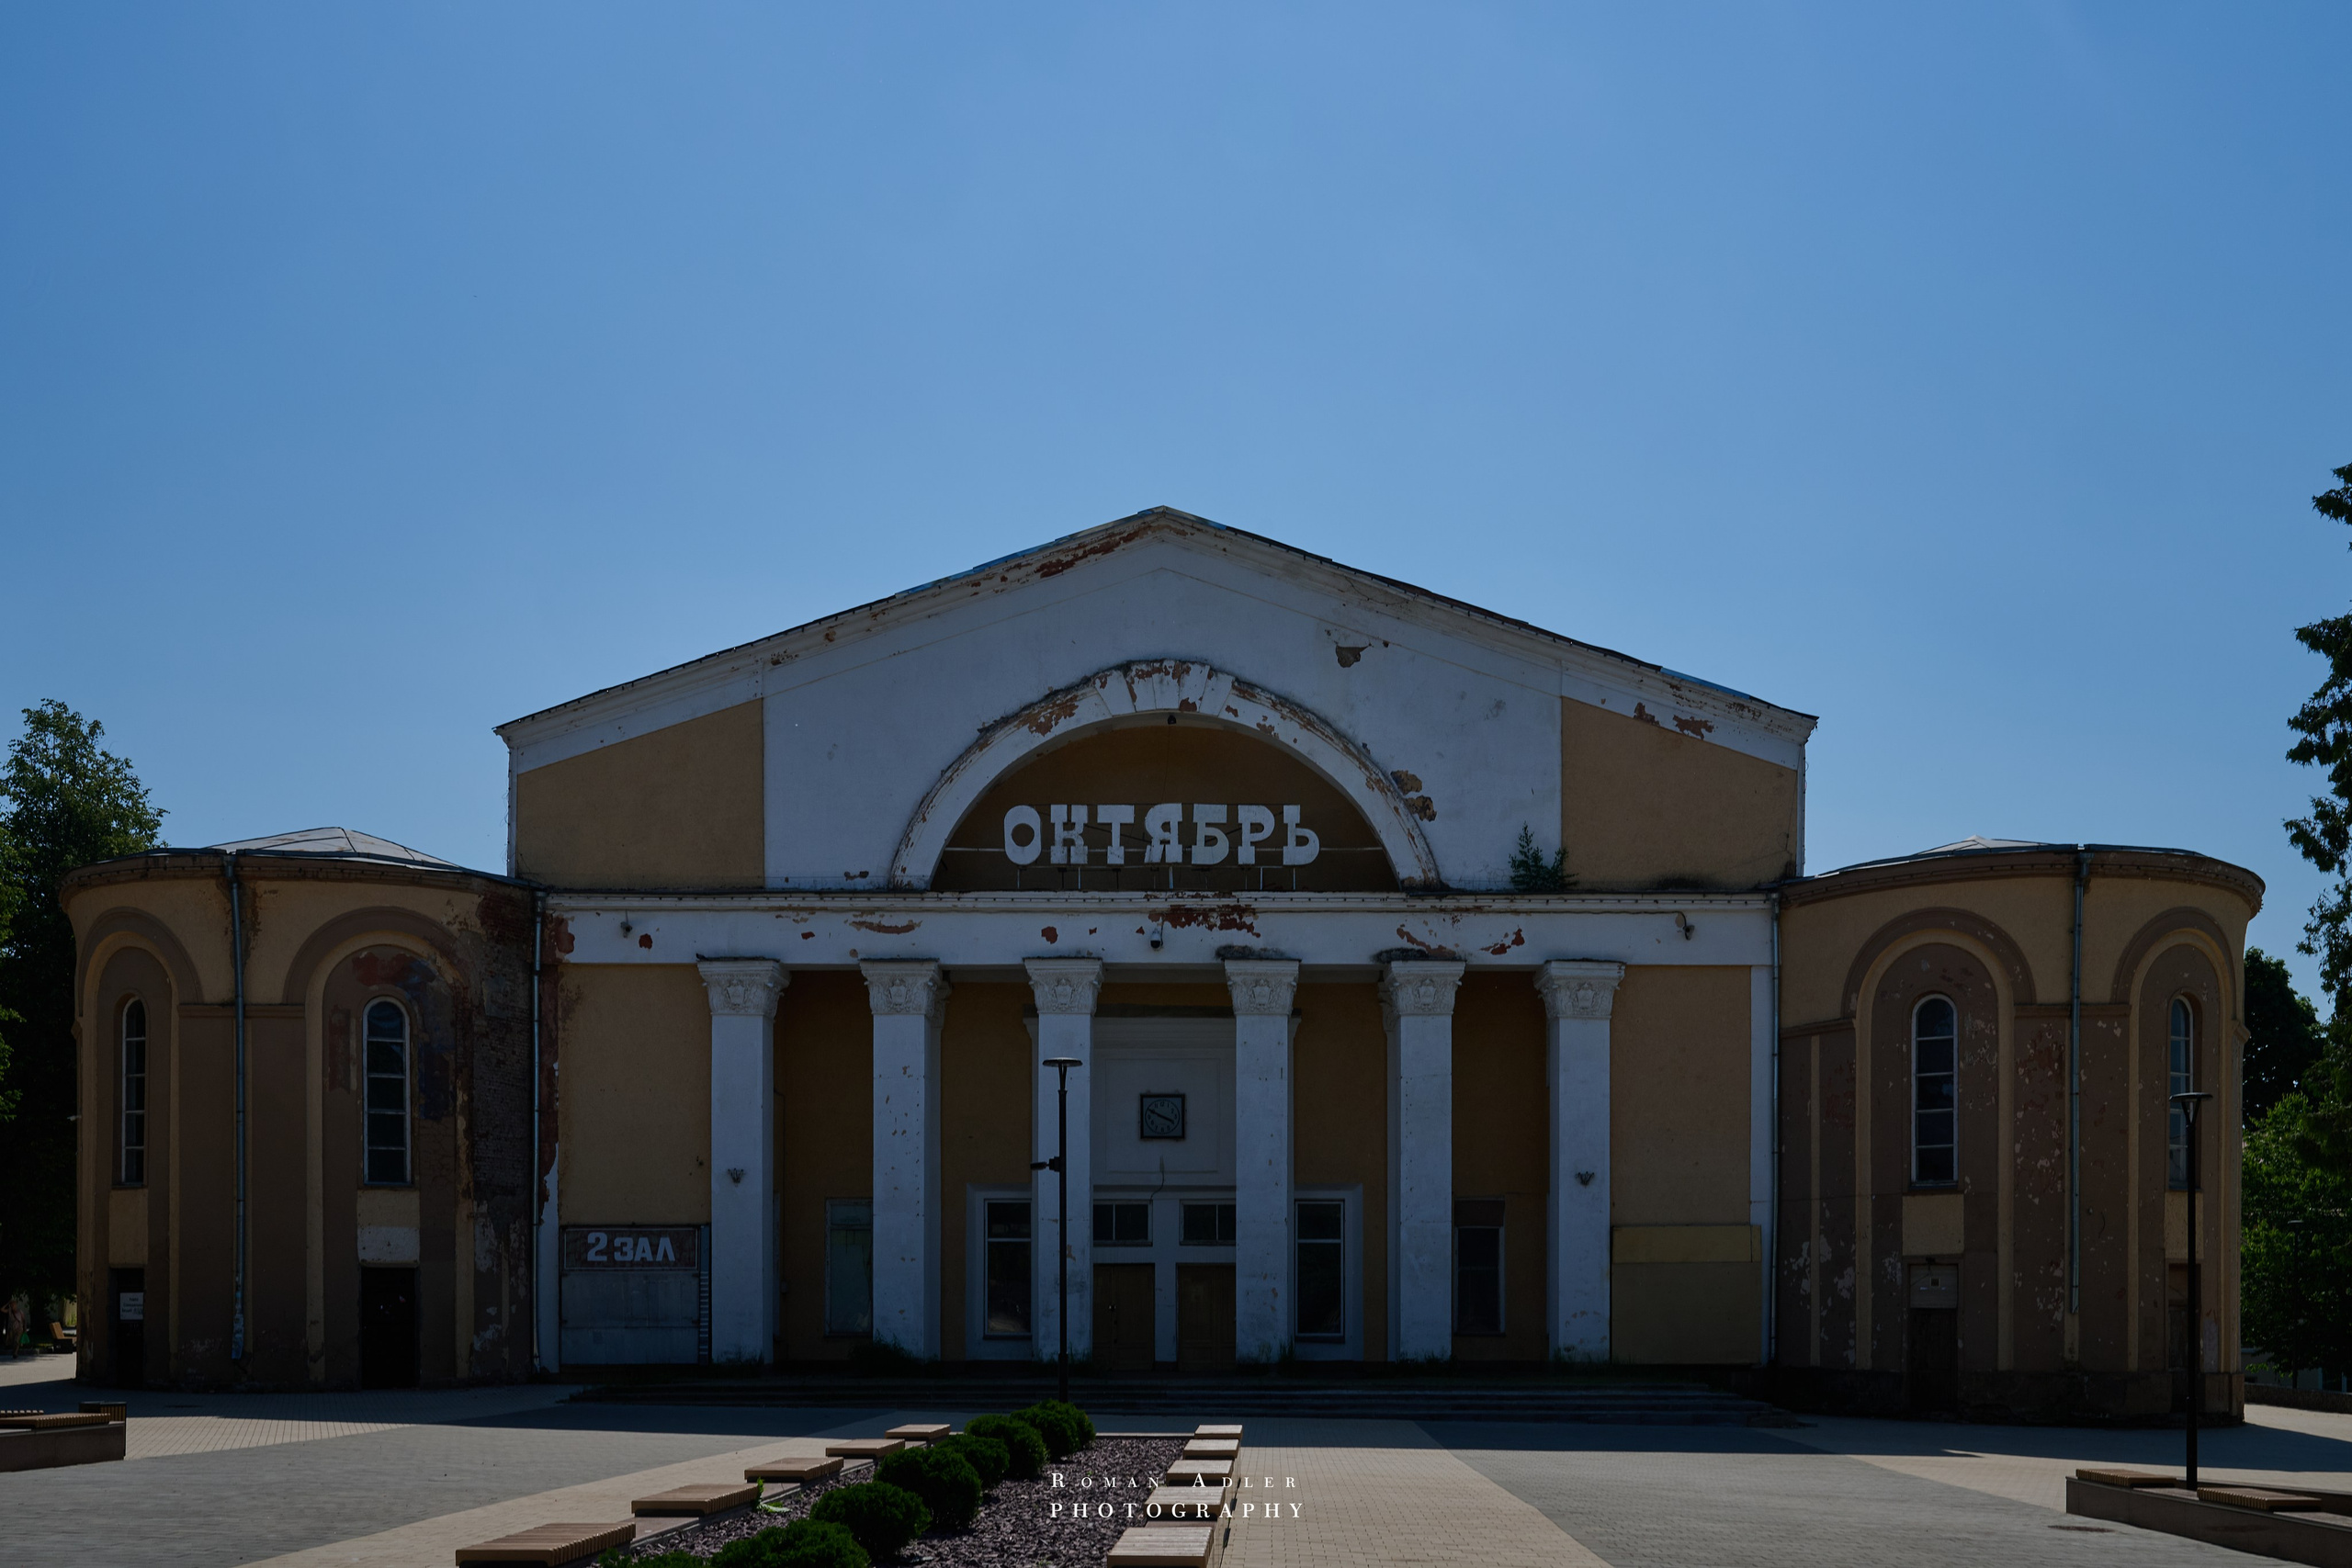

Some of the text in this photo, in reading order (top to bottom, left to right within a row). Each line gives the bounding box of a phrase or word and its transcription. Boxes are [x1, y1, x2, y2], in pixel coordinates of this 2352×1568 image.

[1003, 803, 1320, 866] ОКТЯБРЬ
[587, 1232, 676, 1262] 2 ЗАЛ
